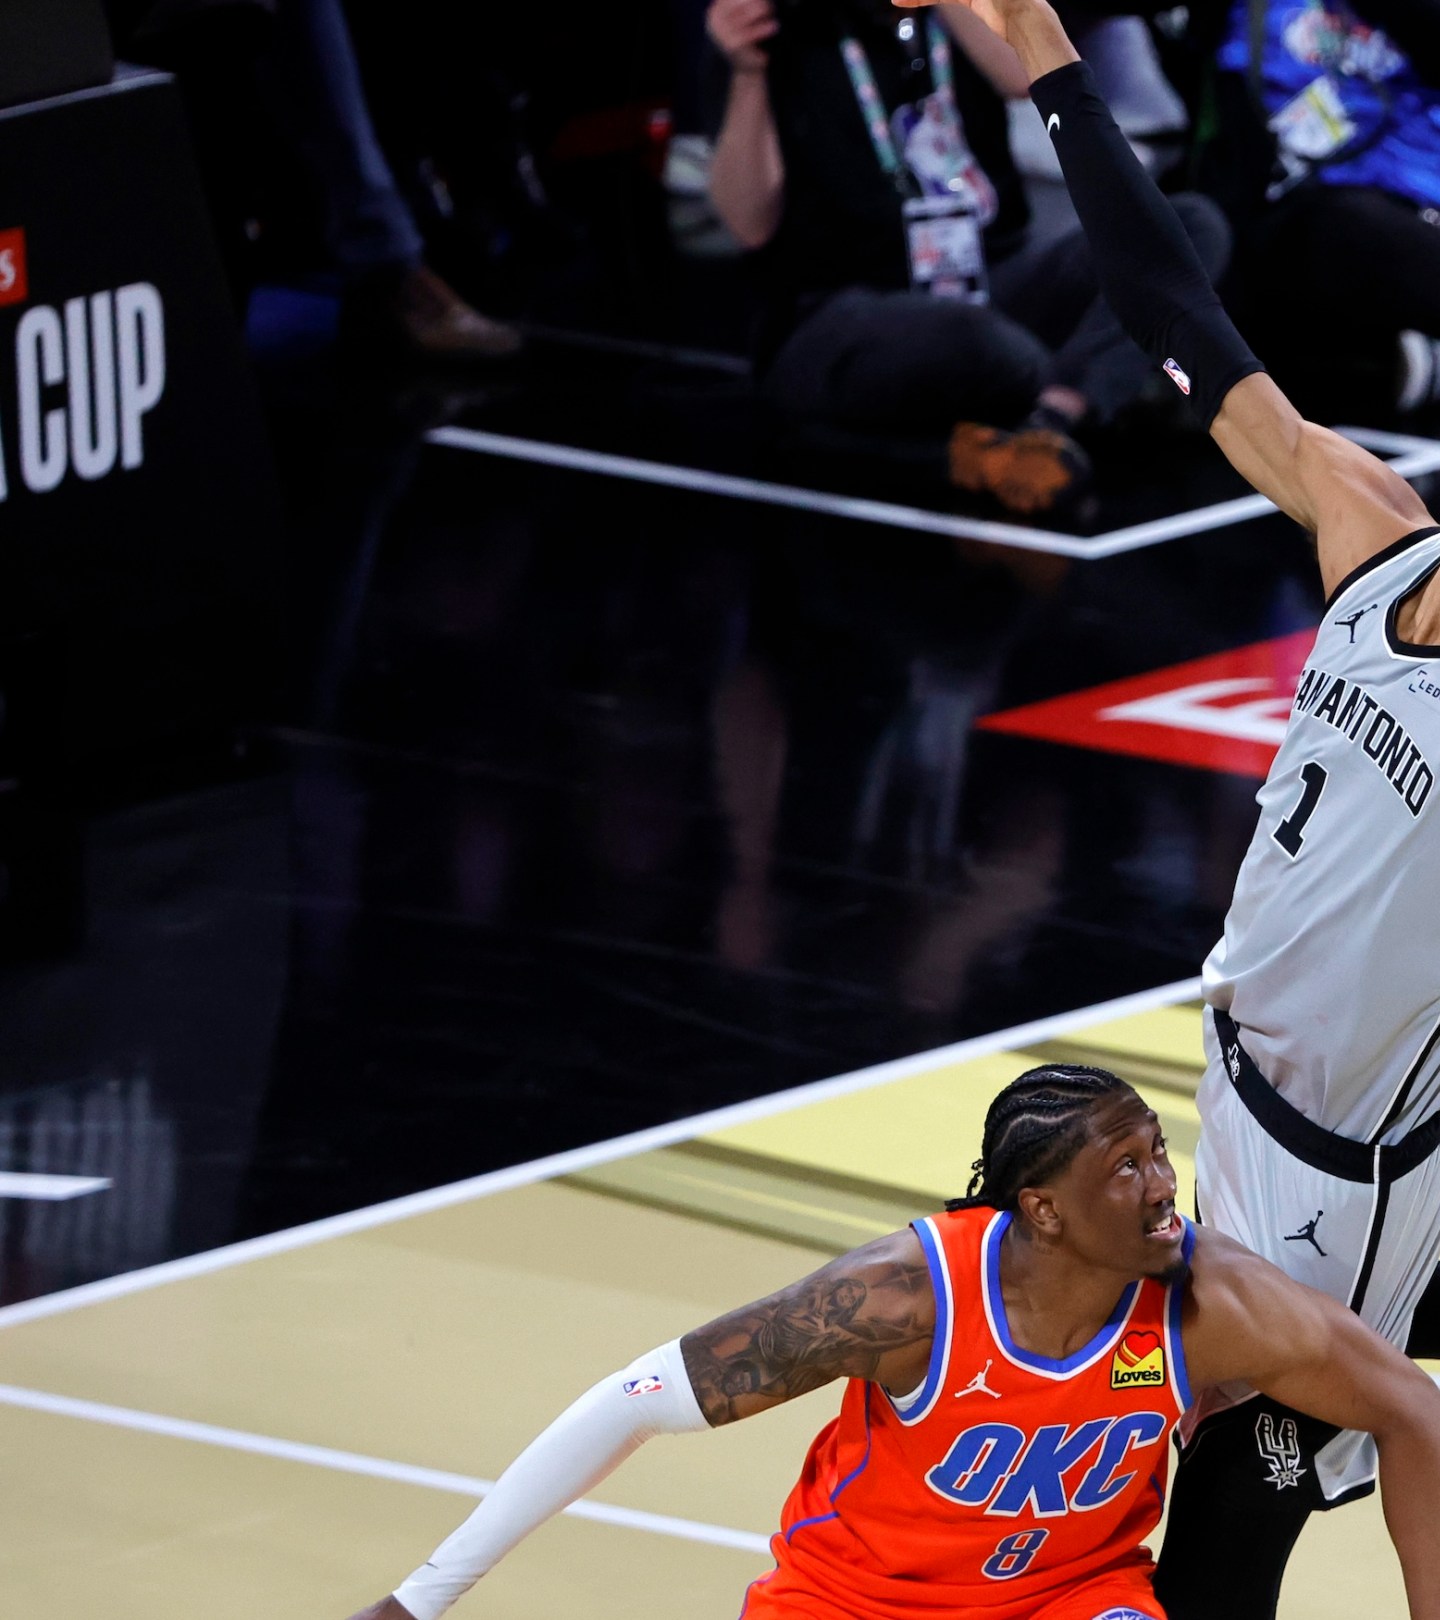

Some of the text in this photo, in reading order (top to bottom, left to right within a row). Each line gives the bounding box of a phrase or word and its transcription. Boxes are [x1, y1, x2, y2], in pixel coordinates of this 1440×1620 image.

[15, 281, 166, 493] CUP
[1313, 675, 1434, 818] ANTONIO
[1272, 761, 1328, 860] 1
[924, 1411, 1167, 1518] OKC
[981, 1527, 1049, 1580] 8
